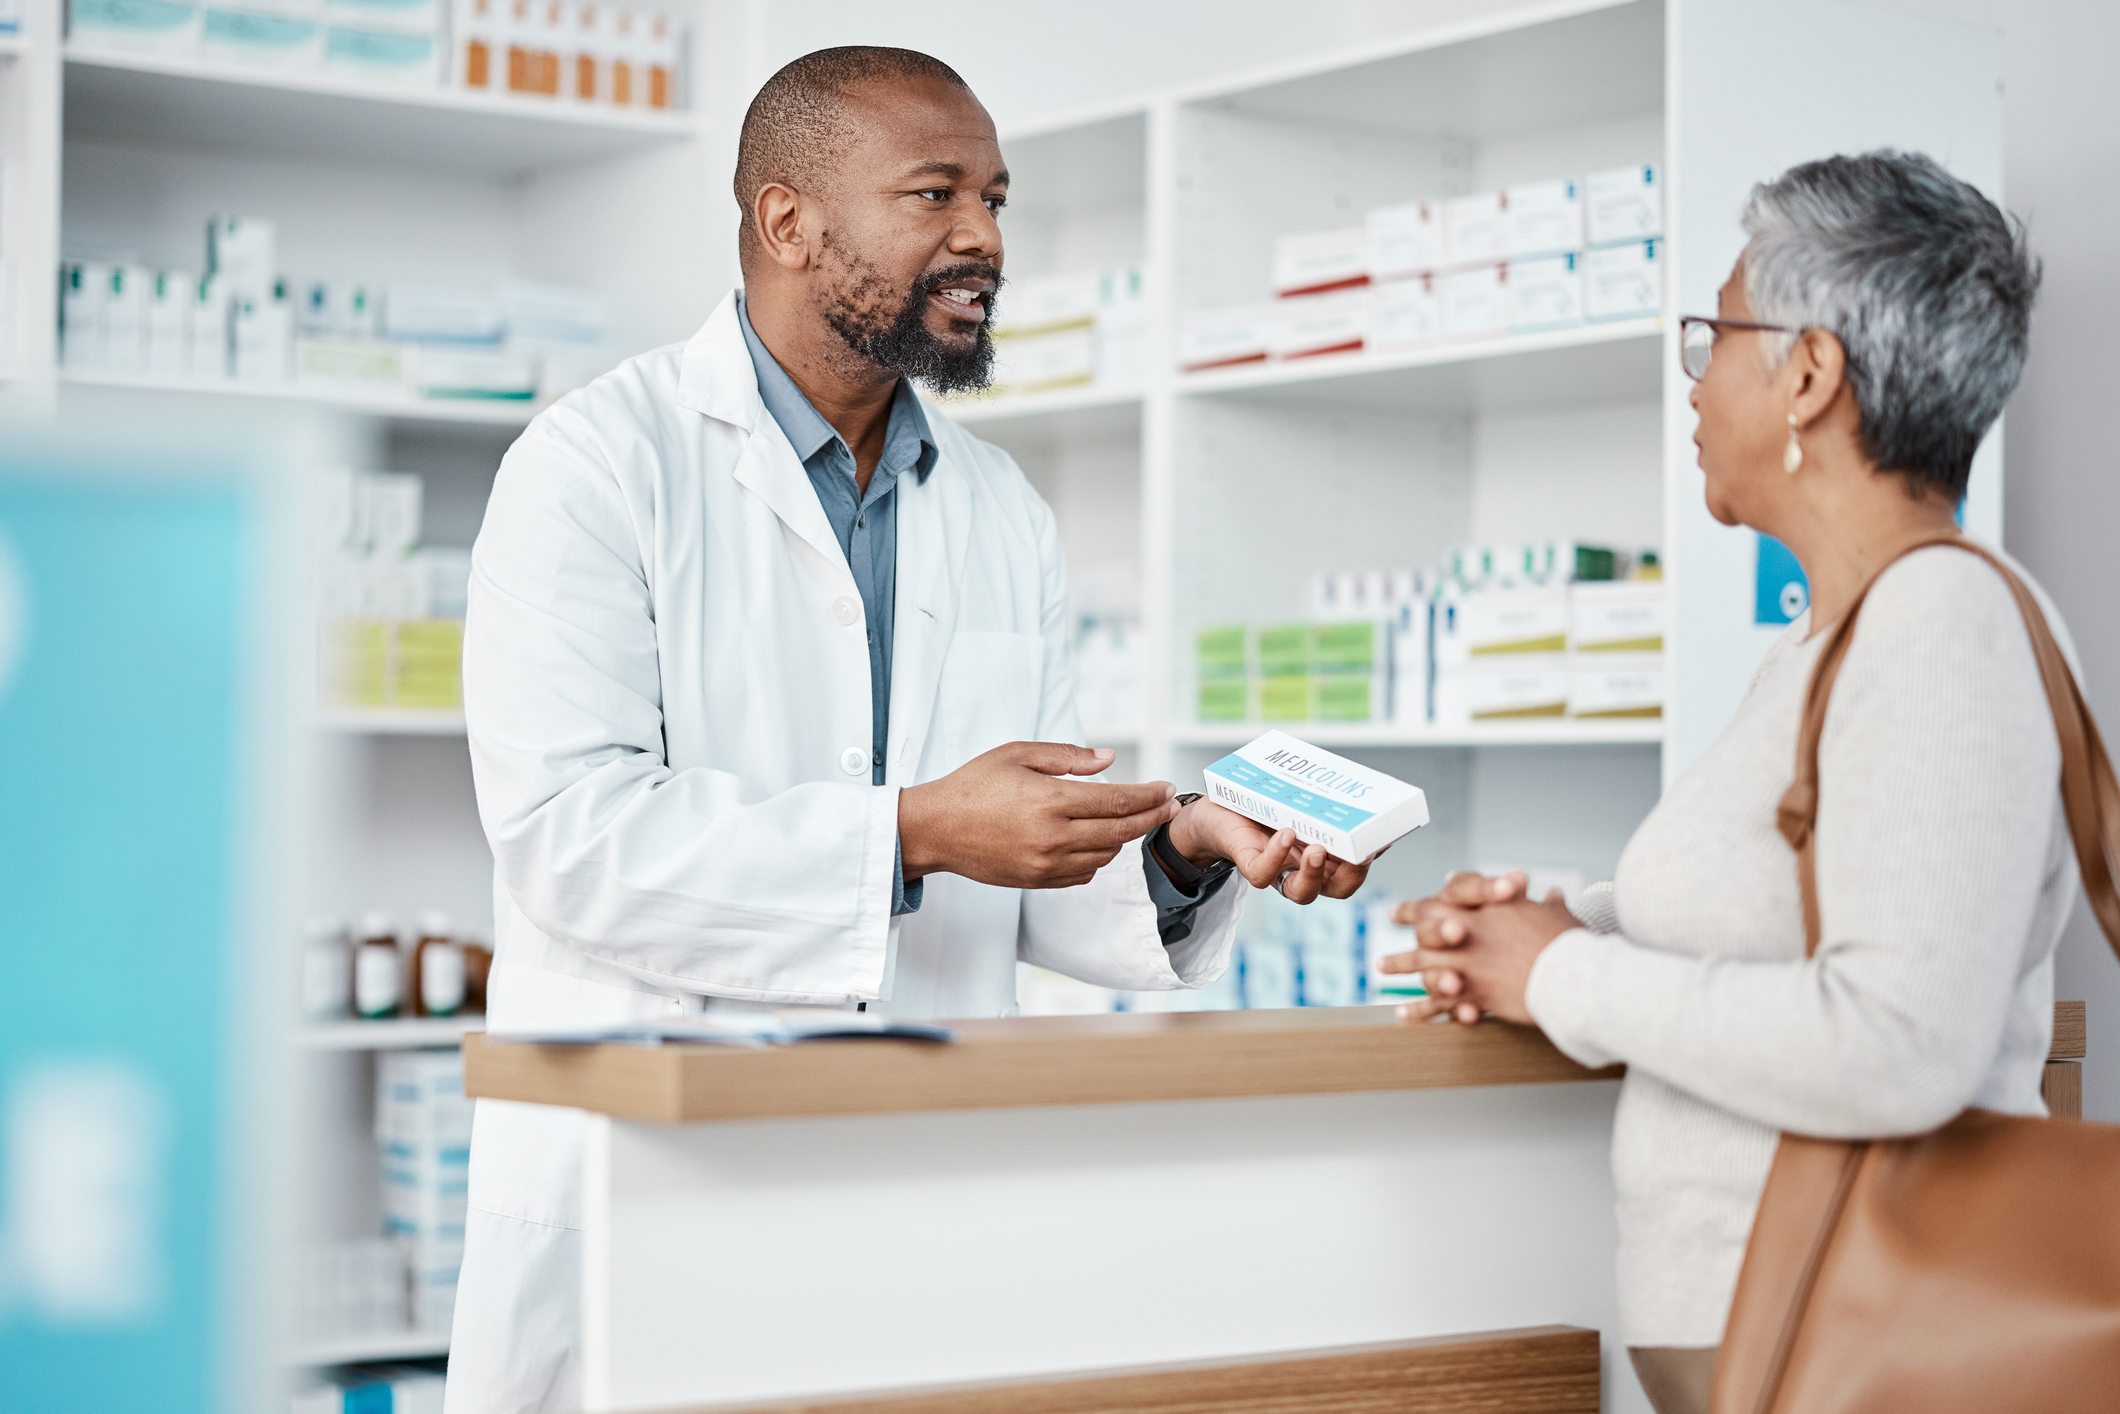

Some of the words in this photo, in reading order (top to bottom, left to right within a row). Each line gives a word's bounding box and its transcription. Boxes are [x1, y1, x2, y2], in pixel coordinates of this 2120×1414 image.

[1264, 749, 1374, 798] MEDICOLINS
[1215, 782, 1278, 822] MEDICOLINS
[1291, 819, 1334, 847] ALLERGY
